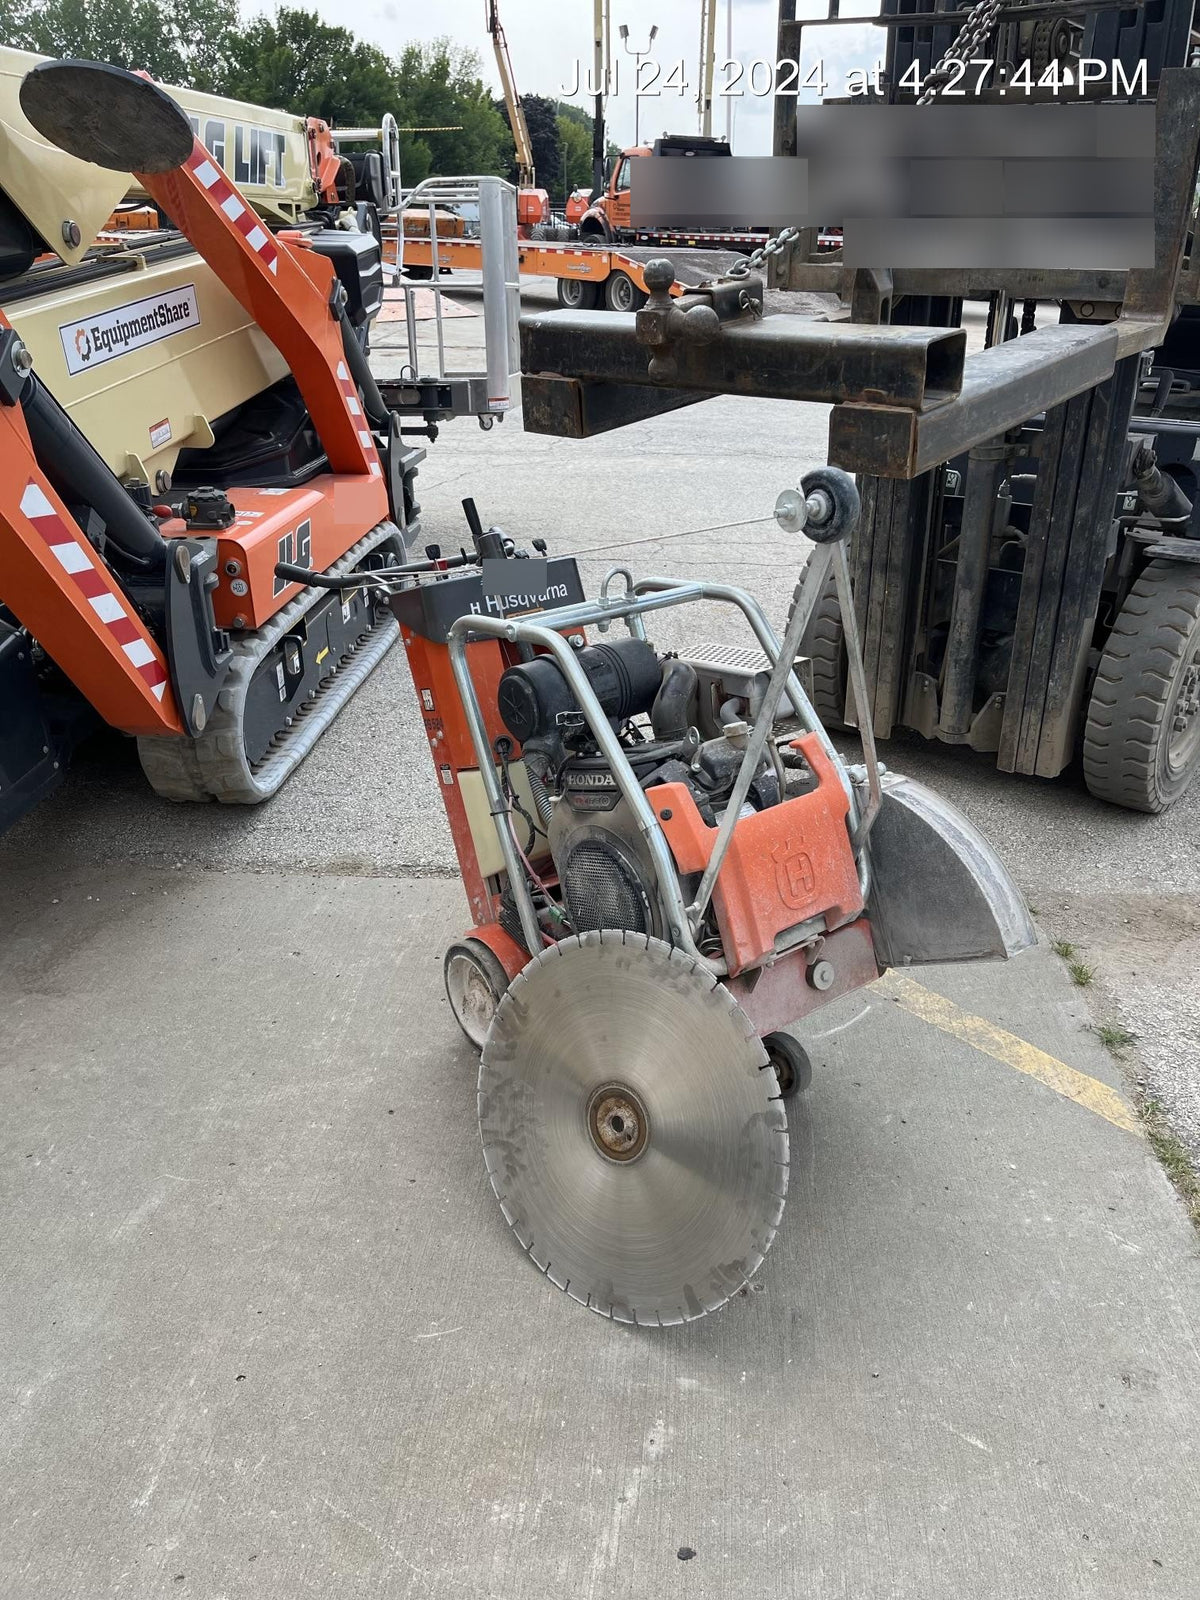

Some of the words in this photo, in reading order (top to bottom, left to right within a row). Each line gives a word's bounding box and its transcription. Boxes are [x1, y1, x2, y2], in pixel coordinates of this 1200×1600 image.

[233, 123, 287, 188] LIFT
[91, 302, 190, 352] EquipmentShare
[568, 774, 616, 786] HONDA
